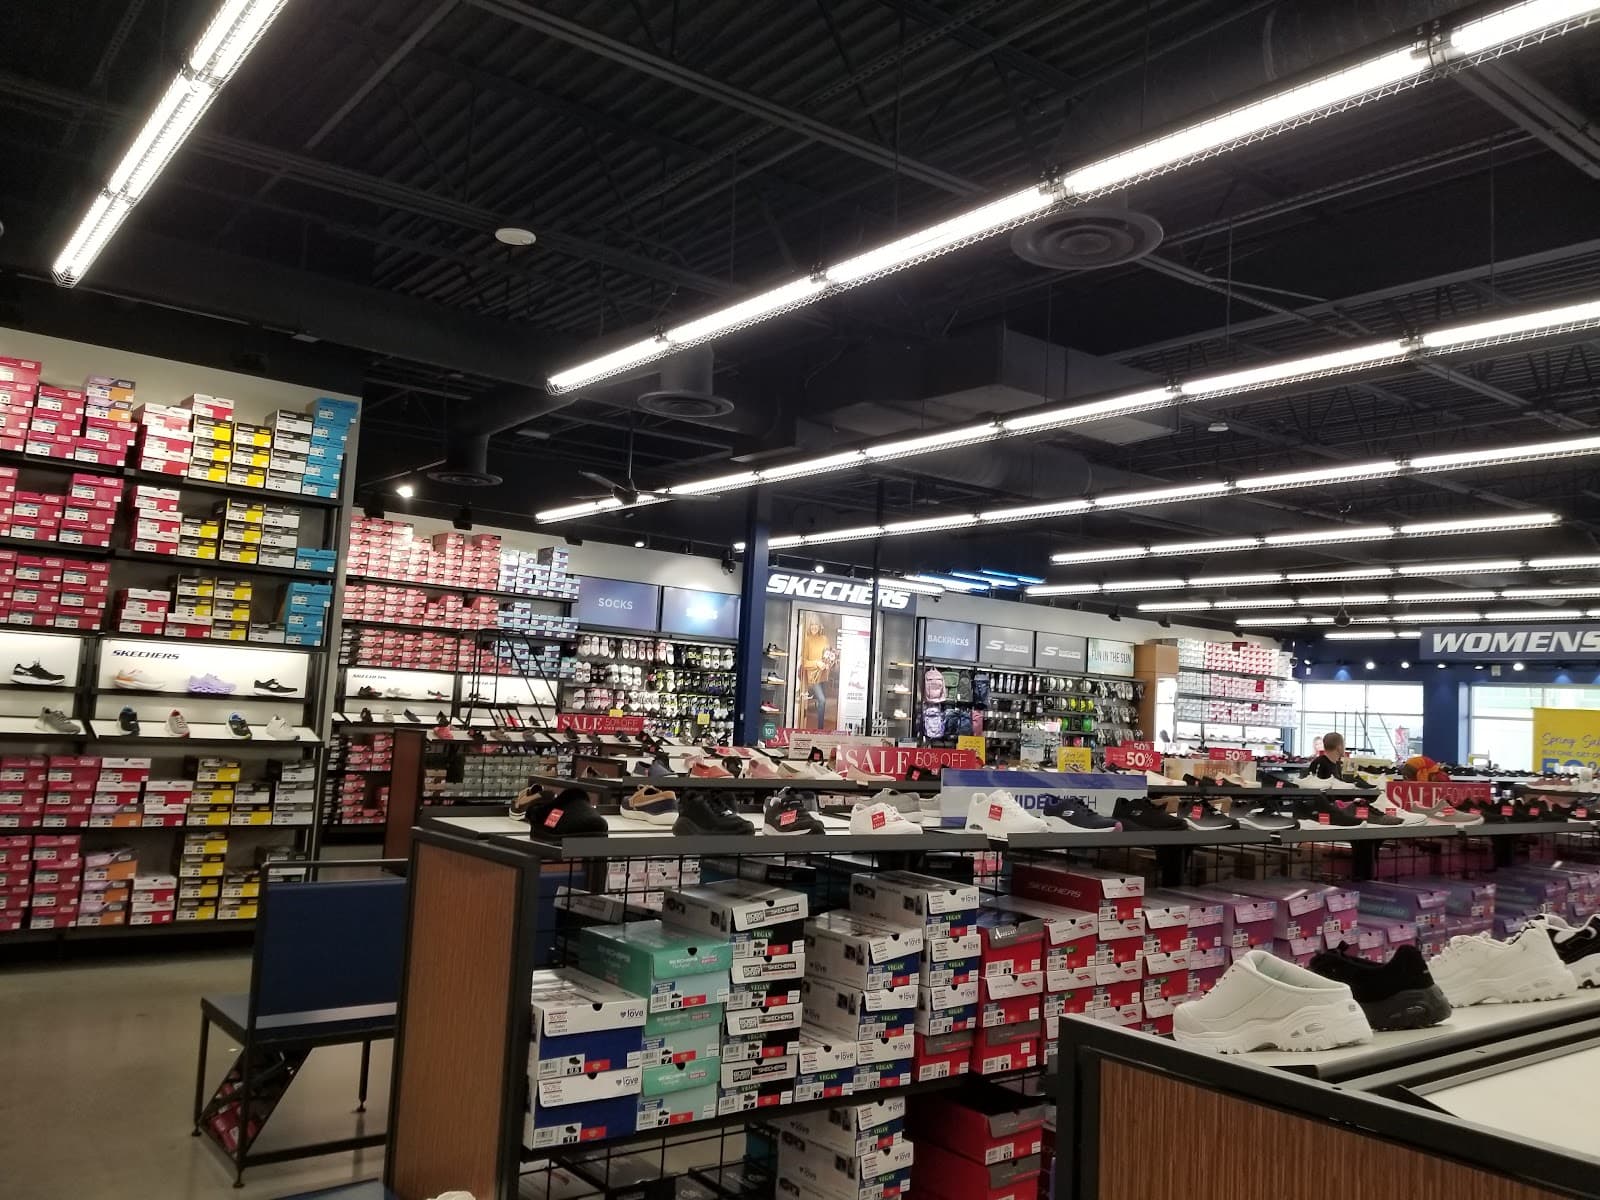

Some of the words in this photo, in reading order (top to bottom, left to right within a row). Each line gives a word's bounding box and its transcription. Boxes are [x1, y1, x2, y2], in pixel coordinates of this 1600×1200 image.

[765, 573, 911, 609] SKECHERS
[598, 597, 633, 610] SOCKS
[927, 634, 969, 647] BACKPACKS
[1433, 631, 1600, 653] WOMENS
[112, 649, 180, 660] SKECHERS
[561, 714, 603, 730] SALE
[845, 749, 910, 775] SALE
[915, 751, 938, 767] 50%
[940, 752, 968, 768] OFF
[1126, 751, 1154, 767] 50%
[1225, 750, 1247, 761] 50%
[1393, 785, 1442, 809] SALE
[1028, 881, 1082, 898] SKECHERS
